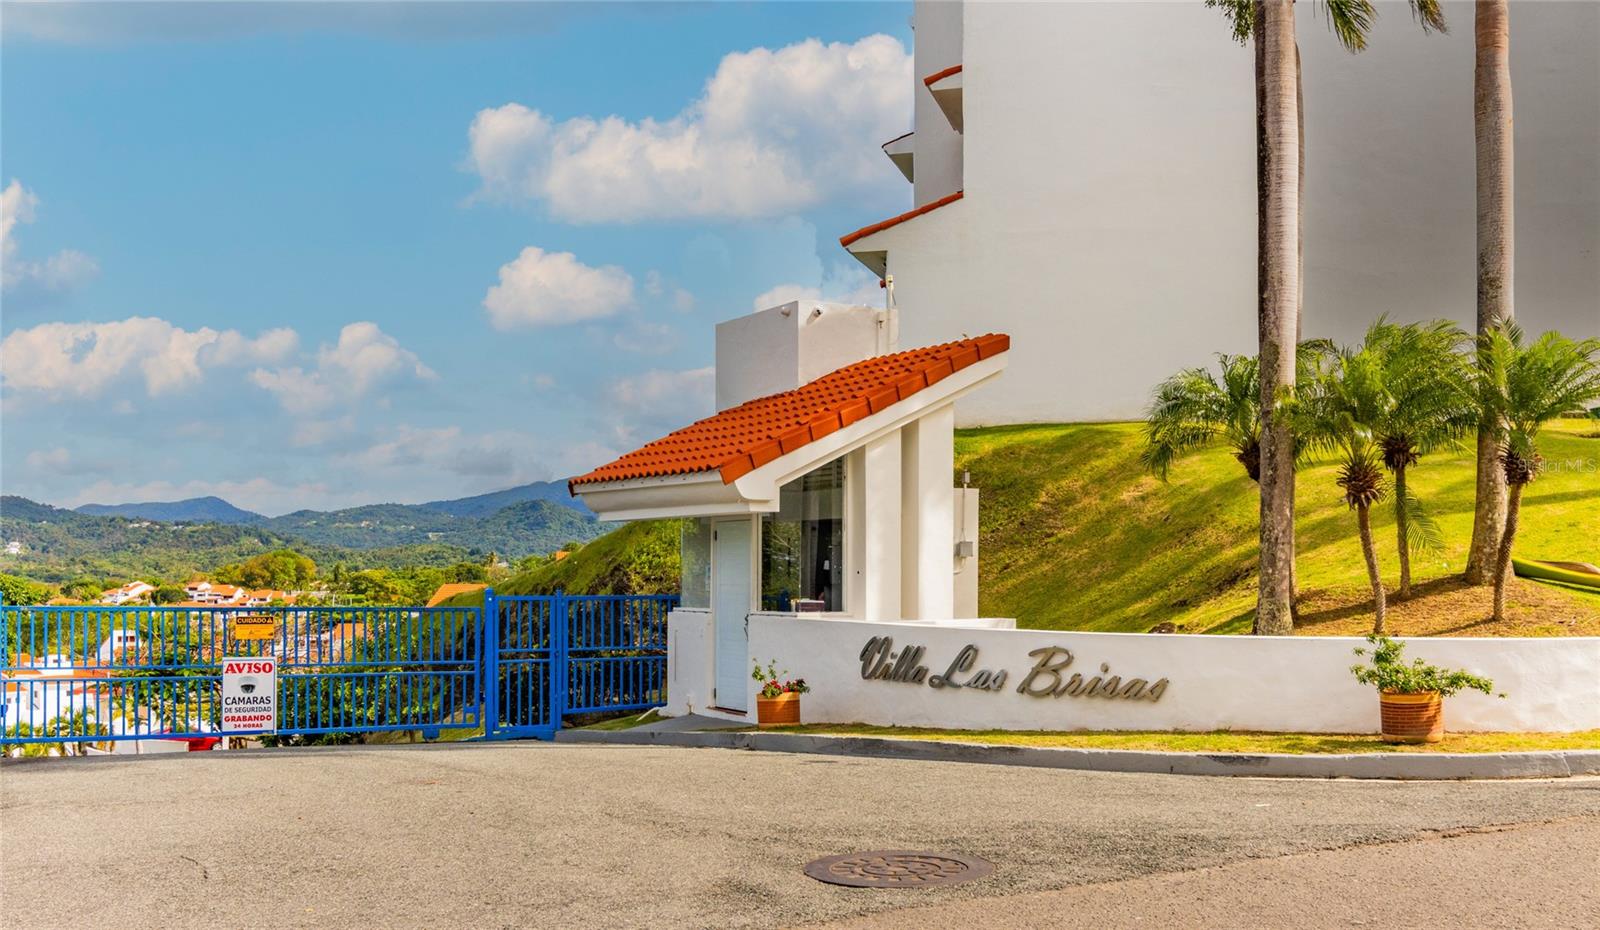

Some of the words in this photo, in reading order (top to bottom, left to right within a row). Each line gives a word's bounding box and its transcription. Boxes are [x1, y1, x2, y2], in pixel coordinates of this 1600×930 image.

[224, 662, 273, 674] AVISO
[860, 635, 929, 685] Villa
[928, 643, 1008, 692] Las
[1016, 645, 1170, 702] Brisas
[224, 696, 272, 706] CAMARAS
[224, 715, 272, 723] GRABANDO
